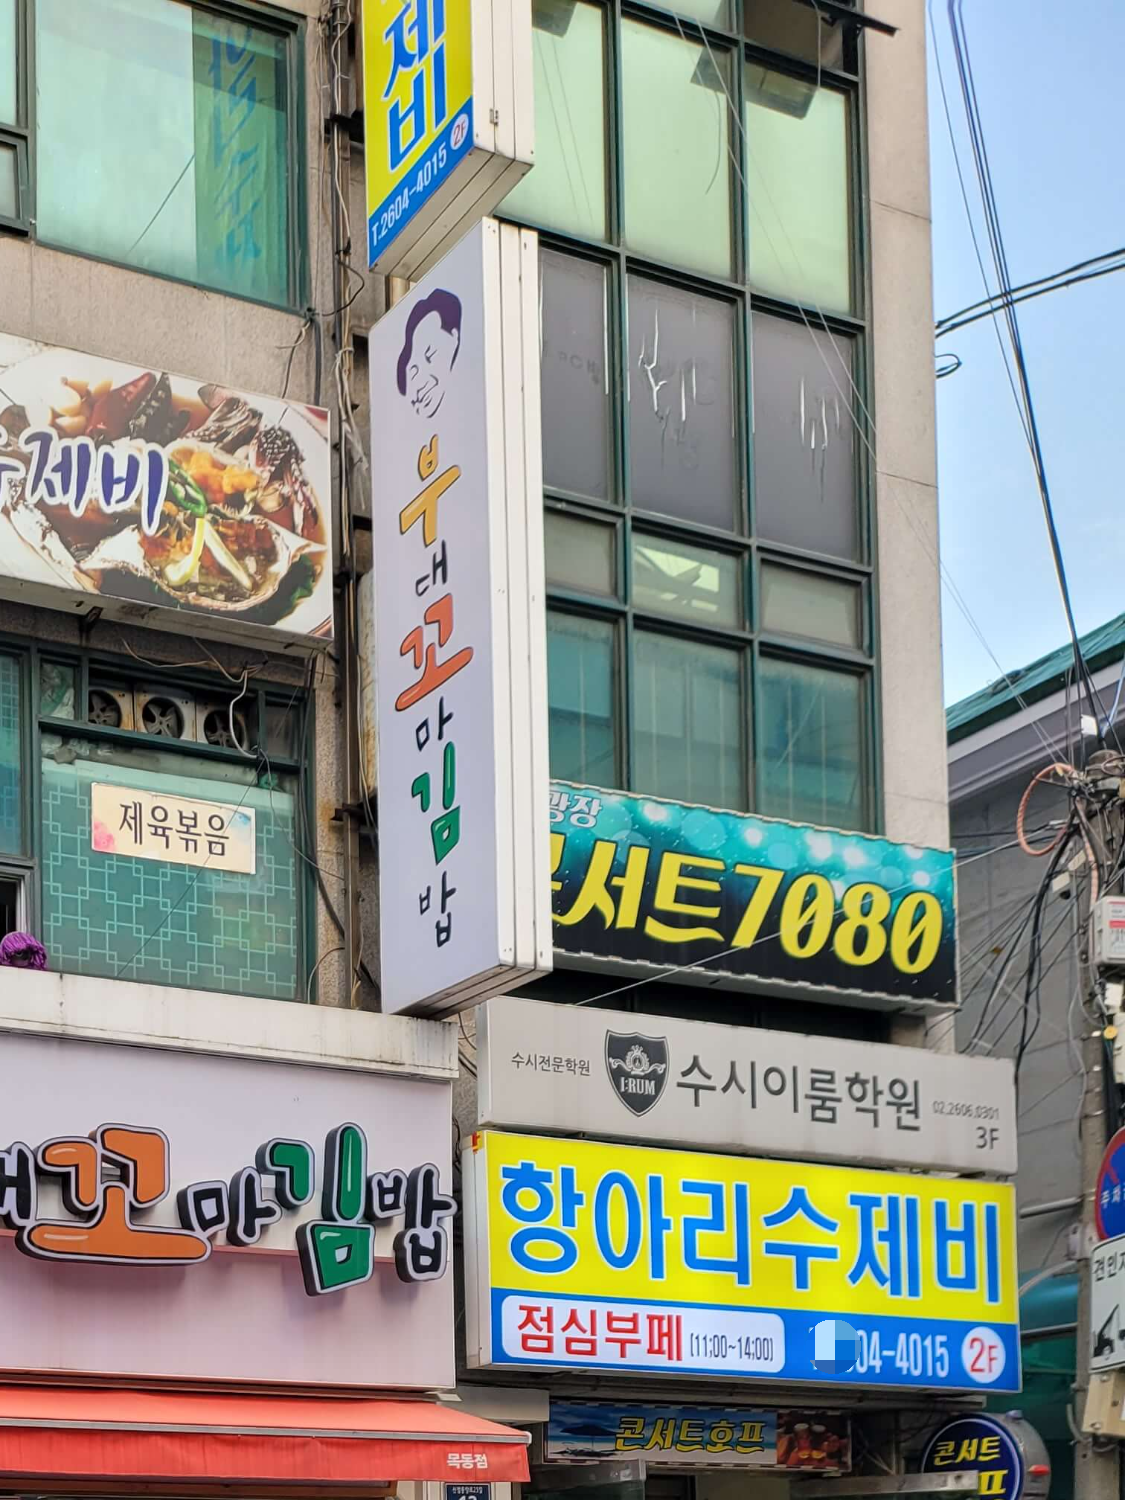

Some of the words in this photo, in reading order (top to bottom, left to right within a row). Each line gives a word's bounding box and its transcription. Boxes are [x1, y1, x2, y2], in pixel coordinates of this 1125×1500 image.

[371, 142, 448, 247] T.2604-4015
[452, 121, 469, 150] 2F
[395, 434, 475, 948] 부대꼬마김밥
[116, 798, 231, 857] 제육볶음
[511, 1051, 591, 1077] 수시전문학원
[676, 1053, 921, 1132] 수시이룸학원
[975, 1125, 1000, 1150] 3F
[500, 1159, 1002, 1305] 항아리수제비
[515, 1303, 683, 1363] 점심부페
[968, 1338, 999, 1374] 2F
[615, 1416, 767, 1453] 콘서트호프
[933, 1435, 1001, 1466] 콘서트
[447, 1453, 488, 1469] 목동점
